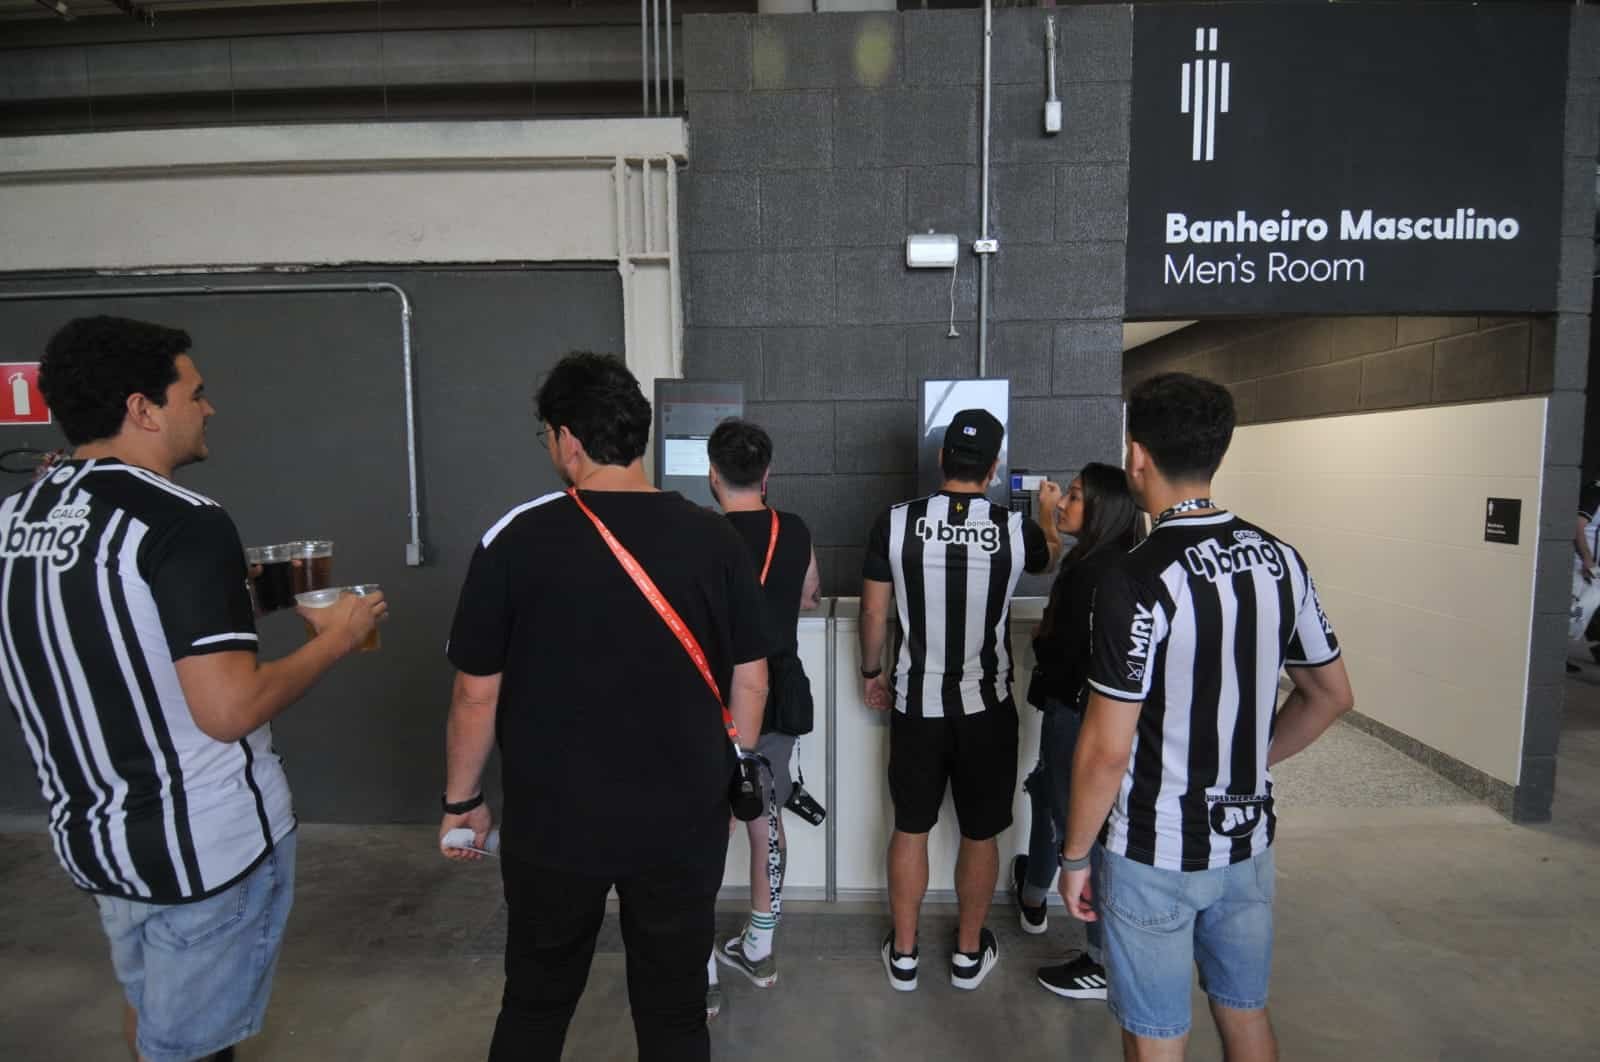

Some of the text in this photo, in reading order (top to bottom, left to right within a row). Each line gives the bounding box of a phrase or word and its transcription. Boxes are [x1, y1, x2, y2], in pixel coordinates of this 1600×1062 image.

[1165, 208, 1520, 243] Banheiro Masculino
[1164, 252, 1365, 284] Men's Room
[51, 508, 87, 519] GALO
[5, 516, 85, 567] bmg
[937, 520, 999, 552] bmg
[1208, 544, 1282, 577] bmg
[1127, 602, 1153, 659] MRV
